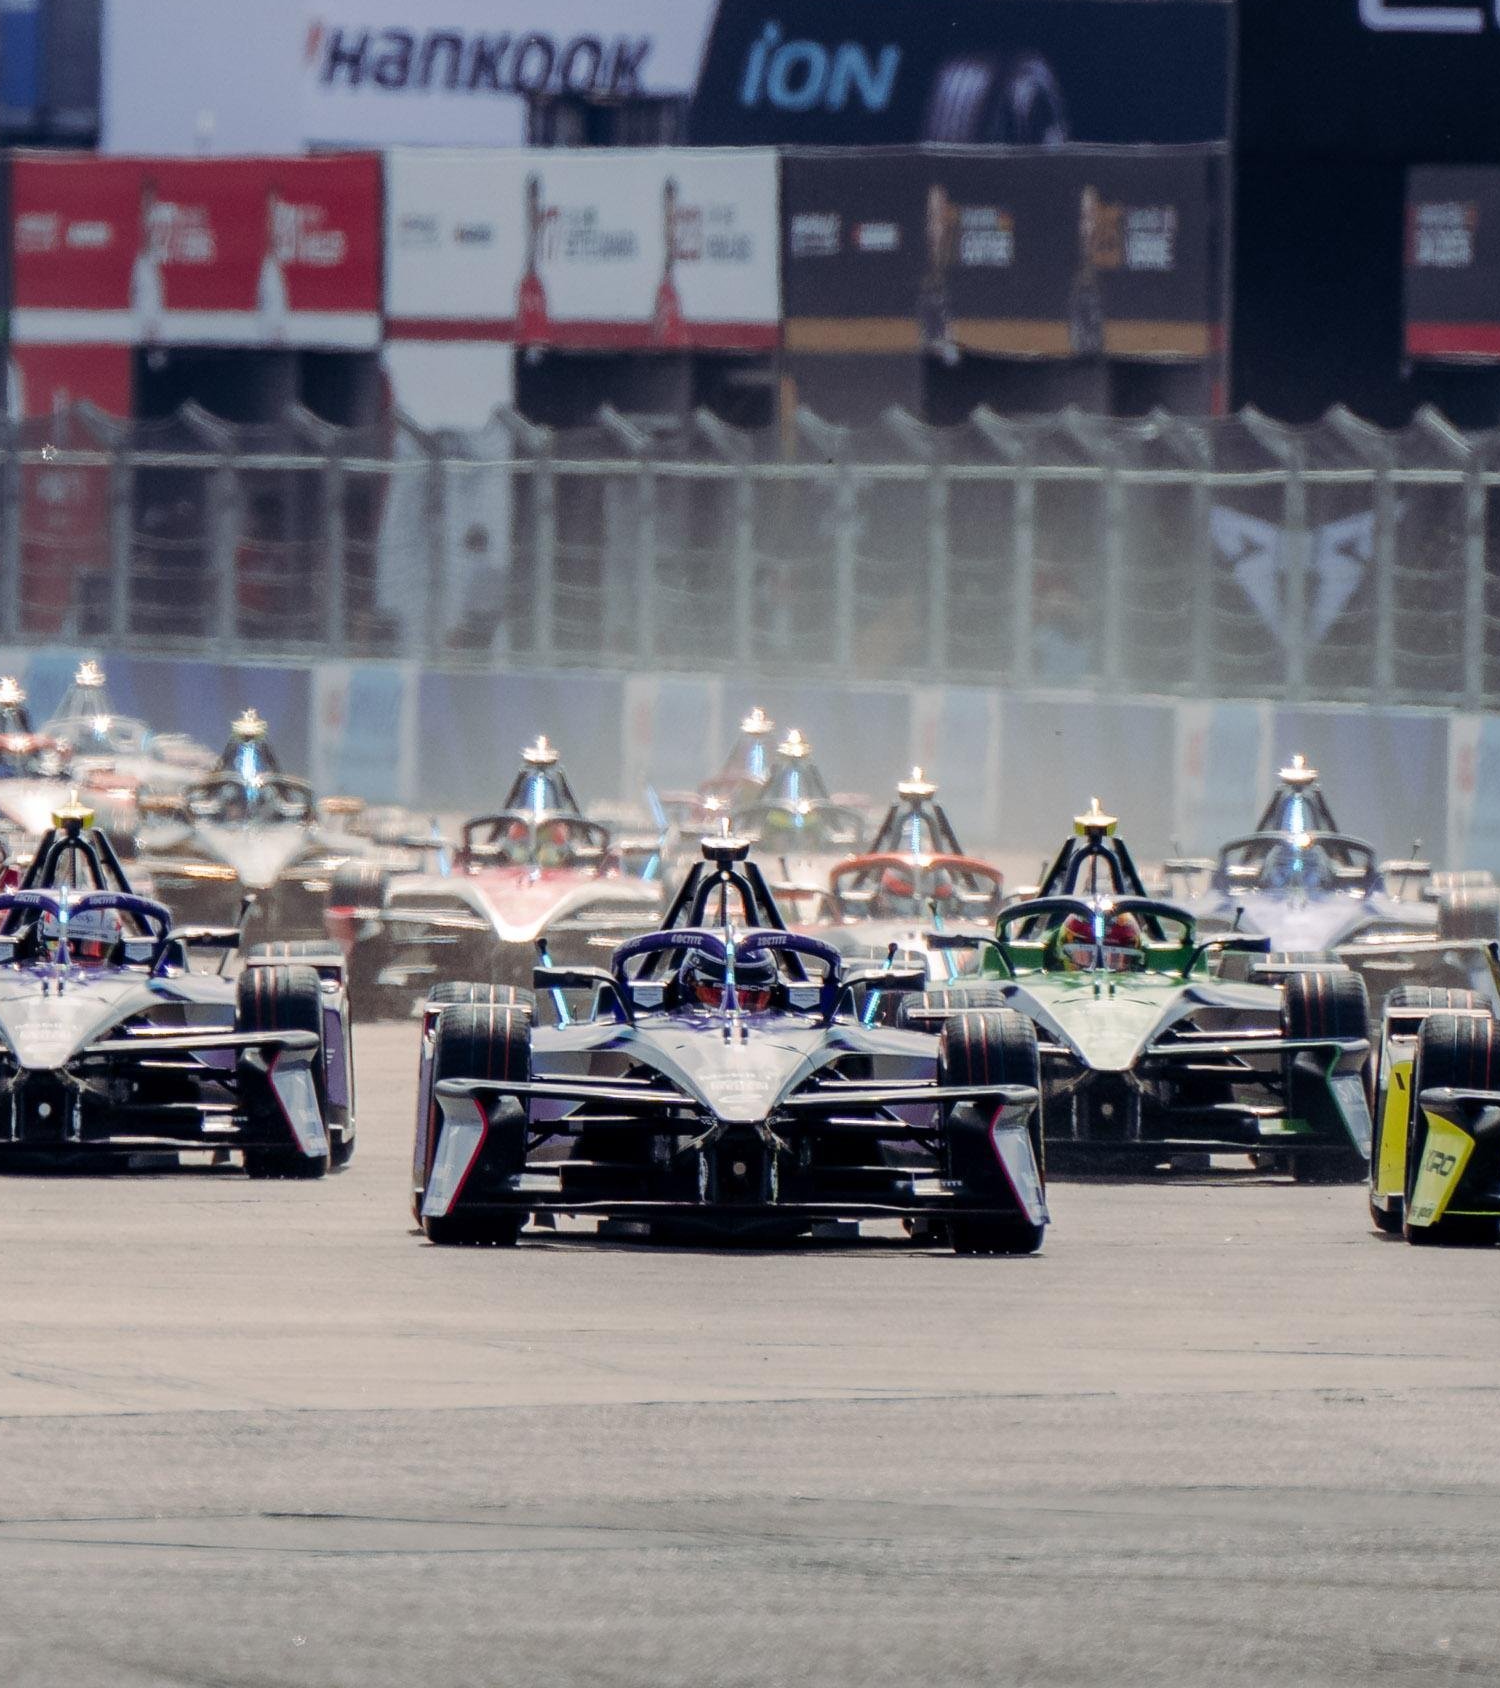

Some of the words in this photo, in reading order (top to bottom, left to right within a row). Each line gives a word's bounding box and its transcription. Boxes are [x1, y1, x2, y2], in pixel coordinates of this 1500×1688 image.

[319, 24, 657, 99] Hankook
[671, 935, 703, 945] LOCTITE
[757, 936, 788, 946] LOCTITE
